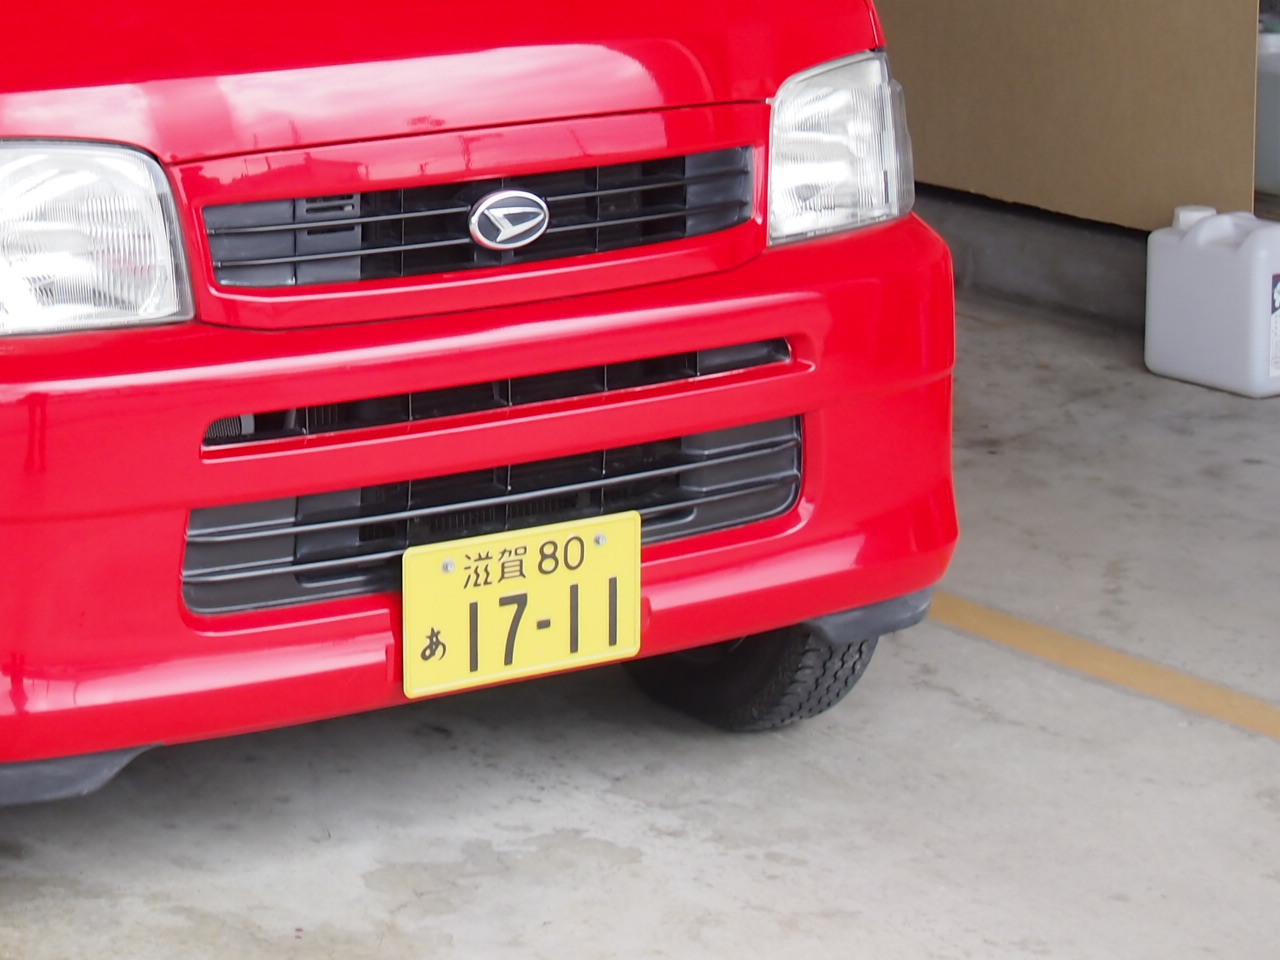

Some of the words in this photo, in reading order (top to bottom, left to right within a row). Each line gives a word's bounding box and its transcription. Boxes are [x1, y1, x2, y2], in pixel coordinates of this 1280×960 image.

[463, 545, 528, 589] 滋賀
[537, 535, 586, 575] 80
[420, 626, 447, 661] あ
[468, 576, 618, 673] 17-11
